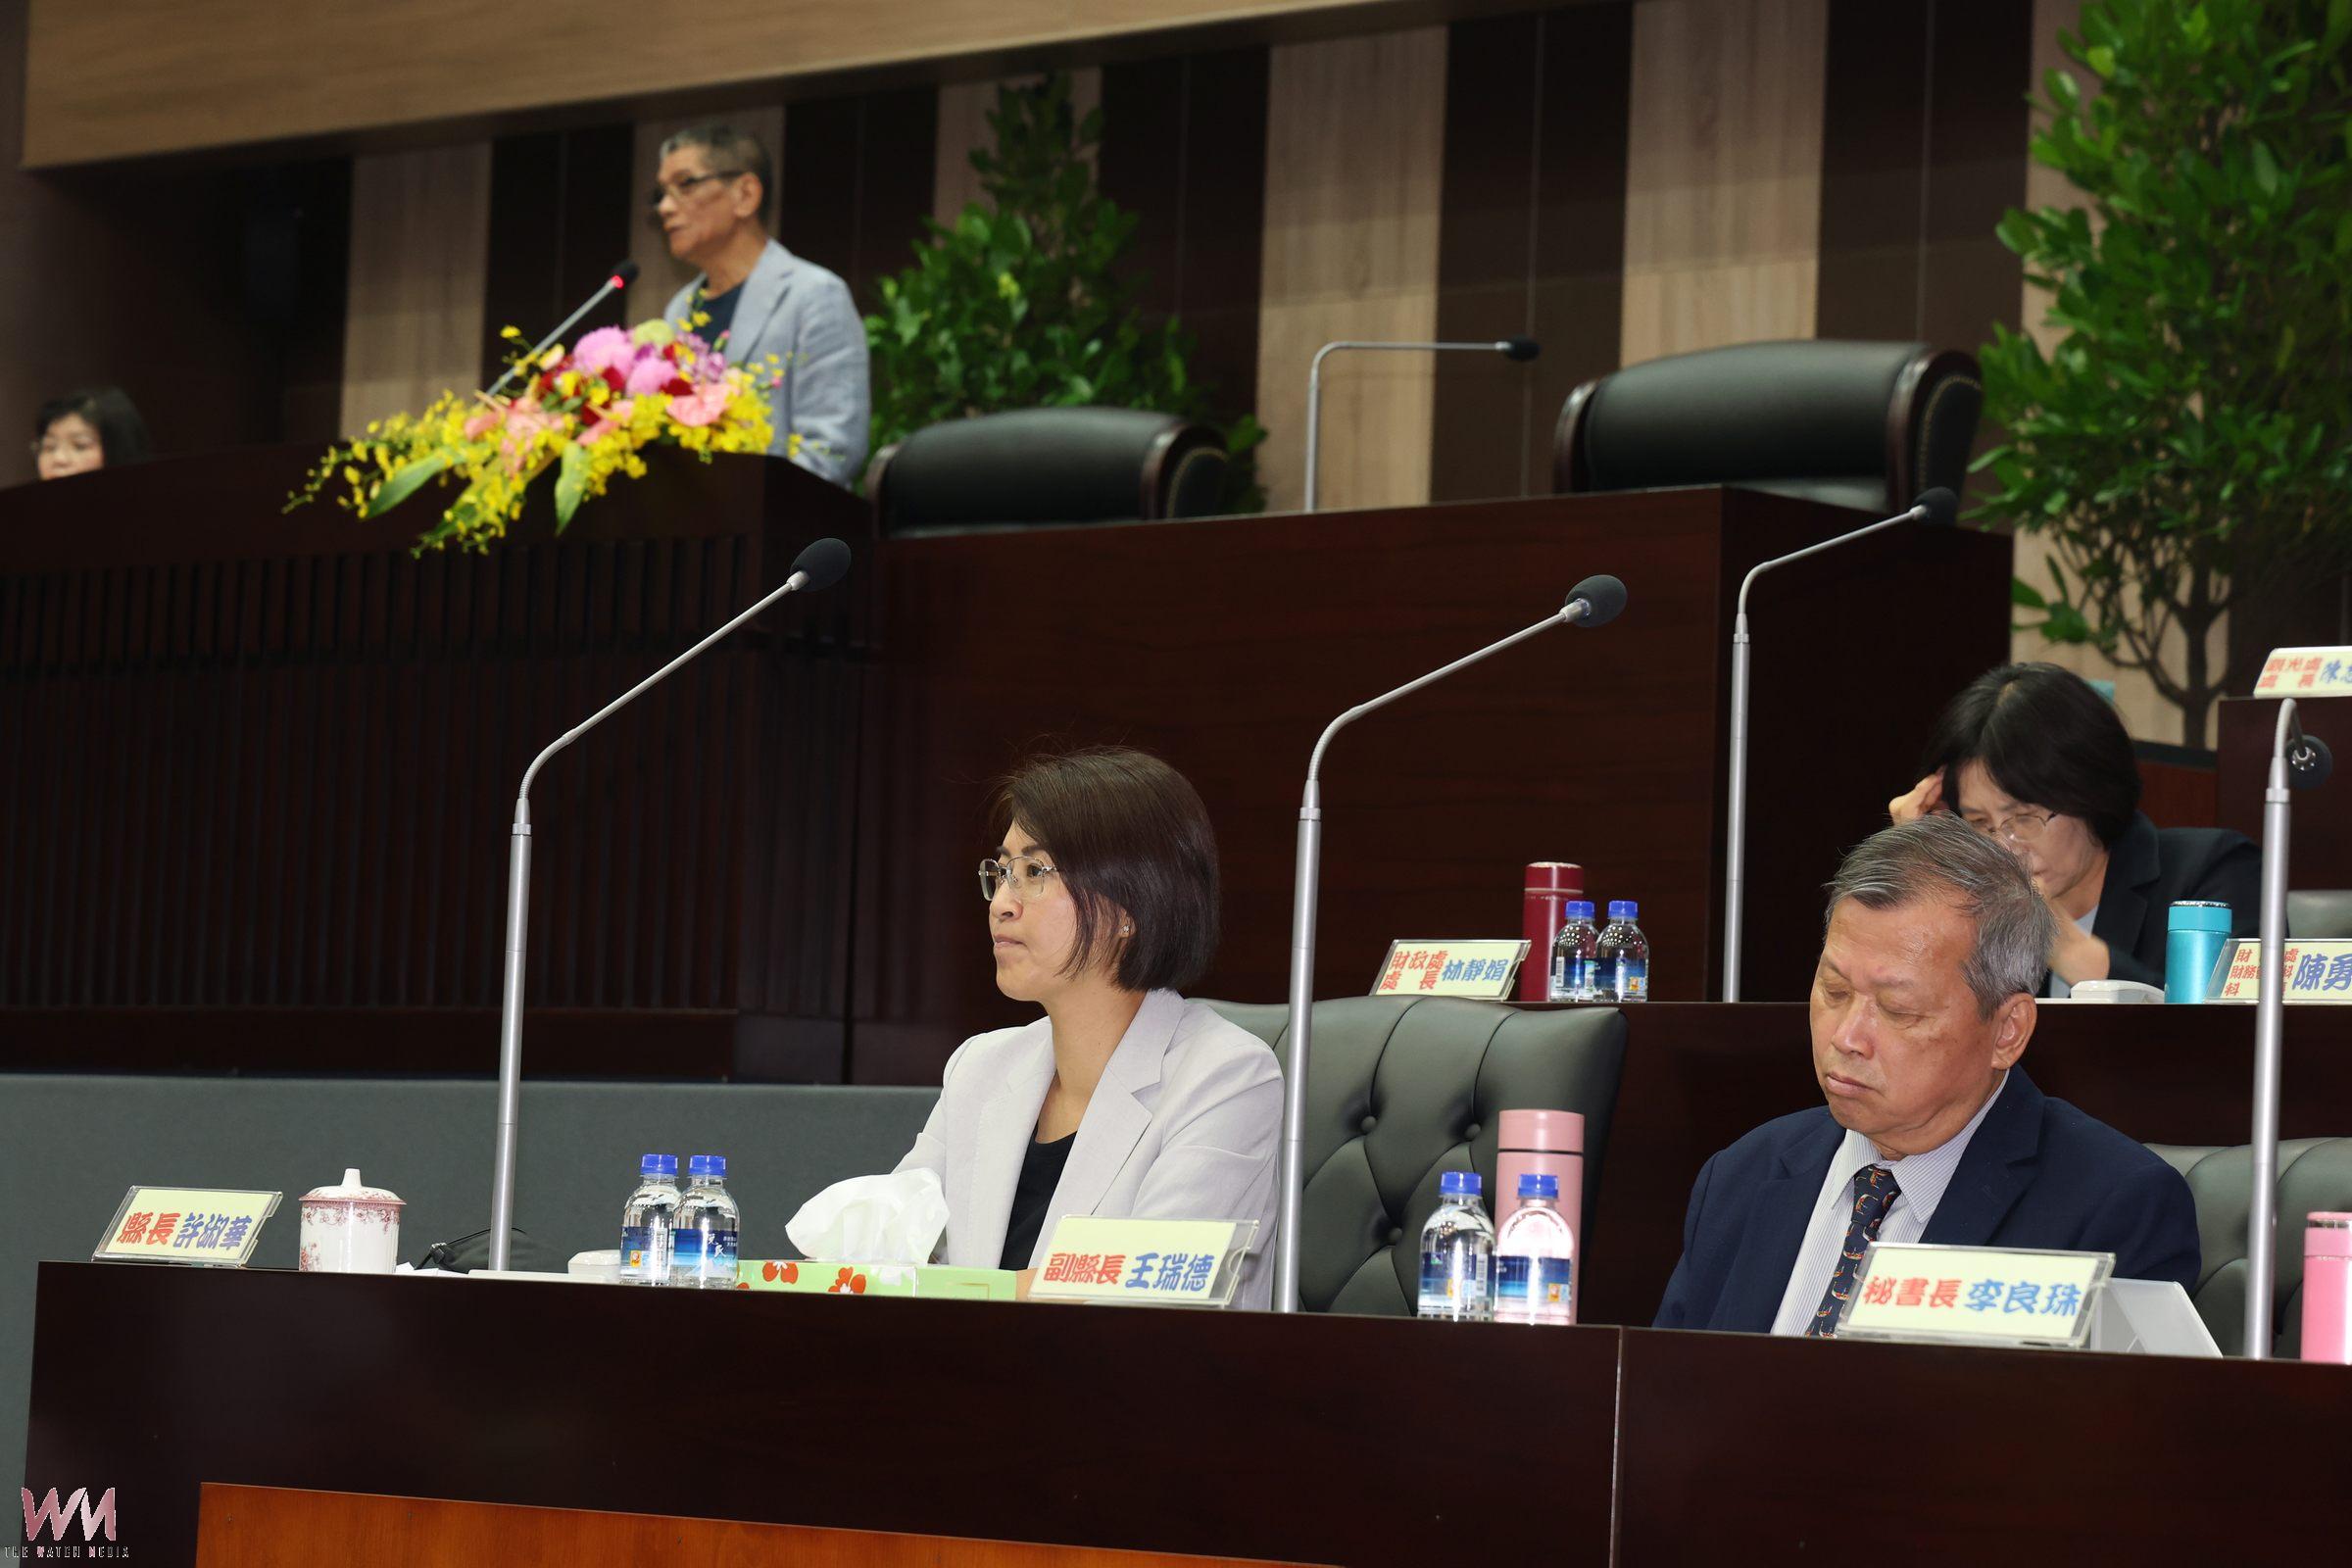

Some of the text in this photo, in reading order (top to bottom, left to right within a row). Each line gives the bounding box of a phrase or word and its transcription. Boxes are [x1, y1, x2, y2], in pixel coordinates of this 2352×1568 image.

[1389, 950, 1448, 970] 財政處
[1442, 958, 1509, 982] 林靜娟
[116, 1211, 252, 1250] 縣長 許淑華
[1043, 1252, 1215, 1292] 副縣長 王瑞德
[1862, 1276, 2082, 1317] 秘書長 李良珠
